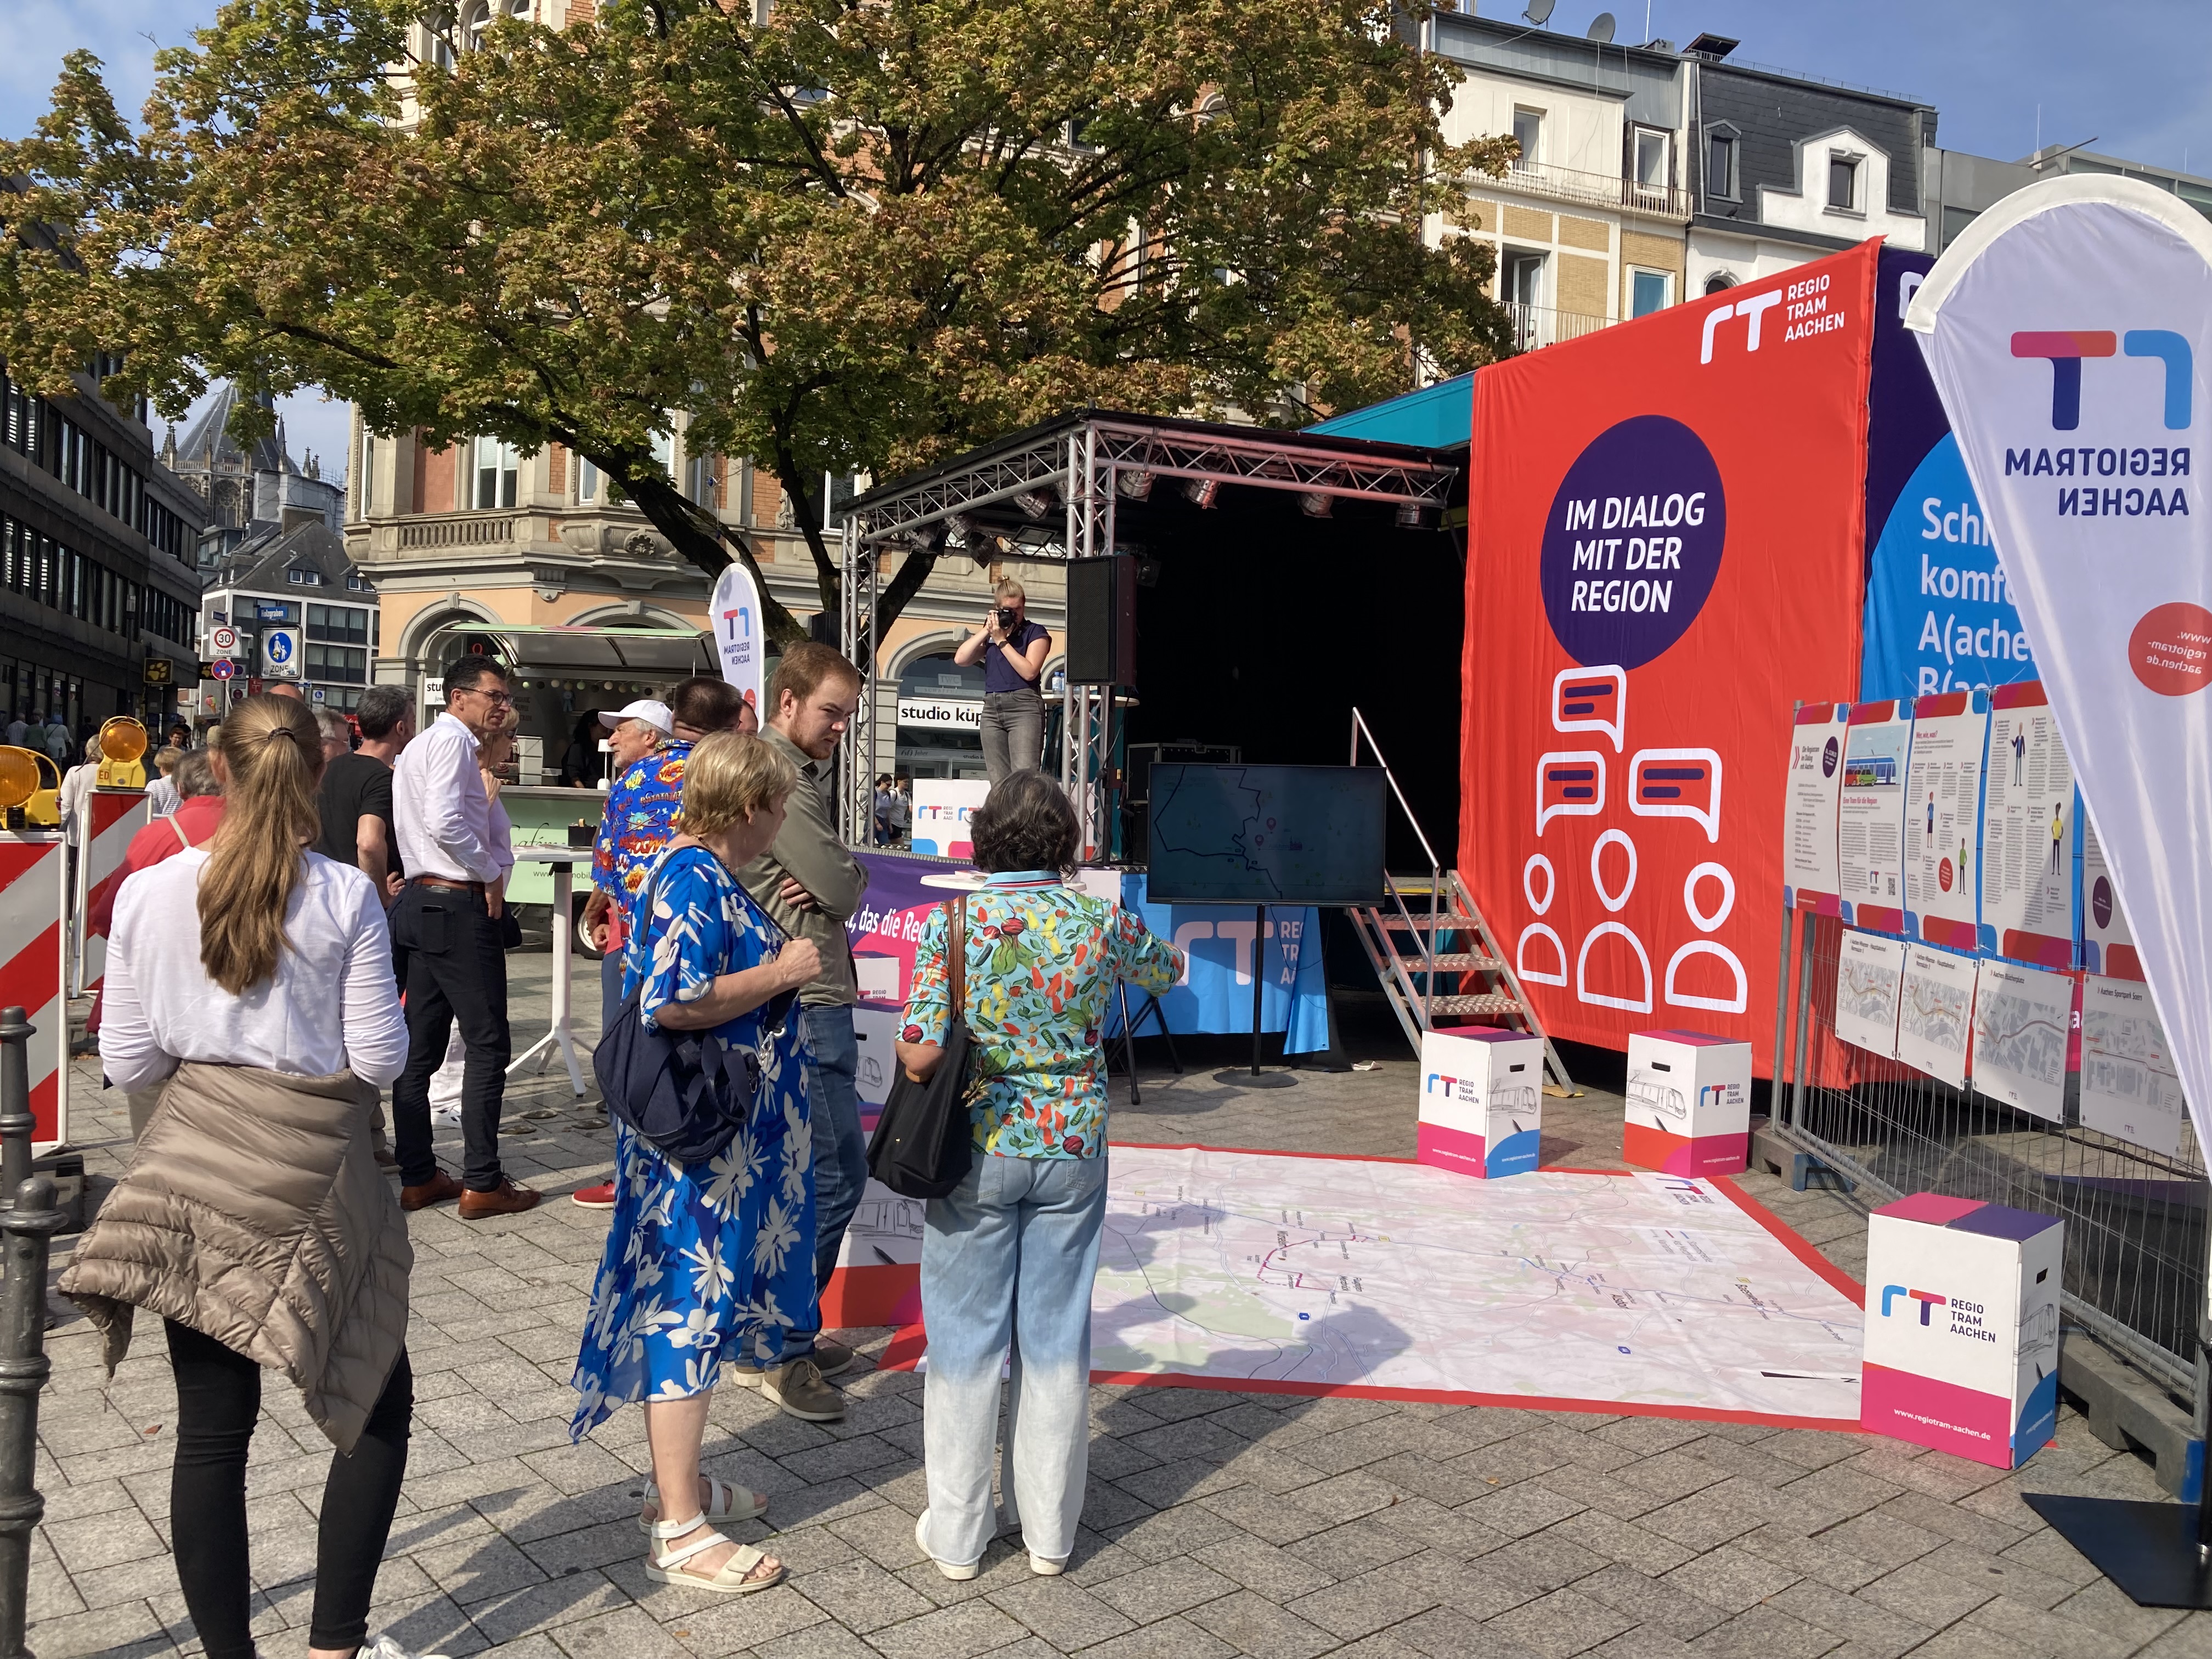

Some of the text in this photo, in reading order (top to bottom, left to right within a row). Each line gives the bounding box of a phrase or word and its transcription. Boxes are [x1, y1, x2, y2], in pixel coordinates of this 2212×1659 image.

[1787, 274, 1830, 301] REGIO
[1786, 295, 1827, 321] TRAM
[1785, 312, 1844, 342] AACHEN
[1565, 492, 1706, 531] IM DIALOG
[1572, 537, 1682, 570] MIT DER
[1571, 580, 1673, 612] REGION
[261, 609, 284, 619] Holzgraben
[218, 634, 230, 643] 30
[1918, 610, 2035, 665] A(ache
[427, 683, 442, 692] stu
[901, 706, 982, 726] studio küp
[99, 770, 109, 780] ED
[859, 903, 880, 934] das
[881, 907, 901, 938] die
[2100, 986, 2143, 1001] Aachen Sportpark Soers
[1459, 1079, 1474, 1087] REGIO
[1459, 1086, 1473, 1095] TRAM
[1458, 1094, 1479, 1104] AACHEN
[1432, 1148, 1476, 1163] www.regiotram-aachen.de
[1951, 1298, 1984, 1314] REGIO
[1951, 1310, 1982, 1327] TRAM
[1950, 1323, 1996, 1342] AACHEN
[1894, 1408, 1991, 1441] www.regiotram-aachen.de
